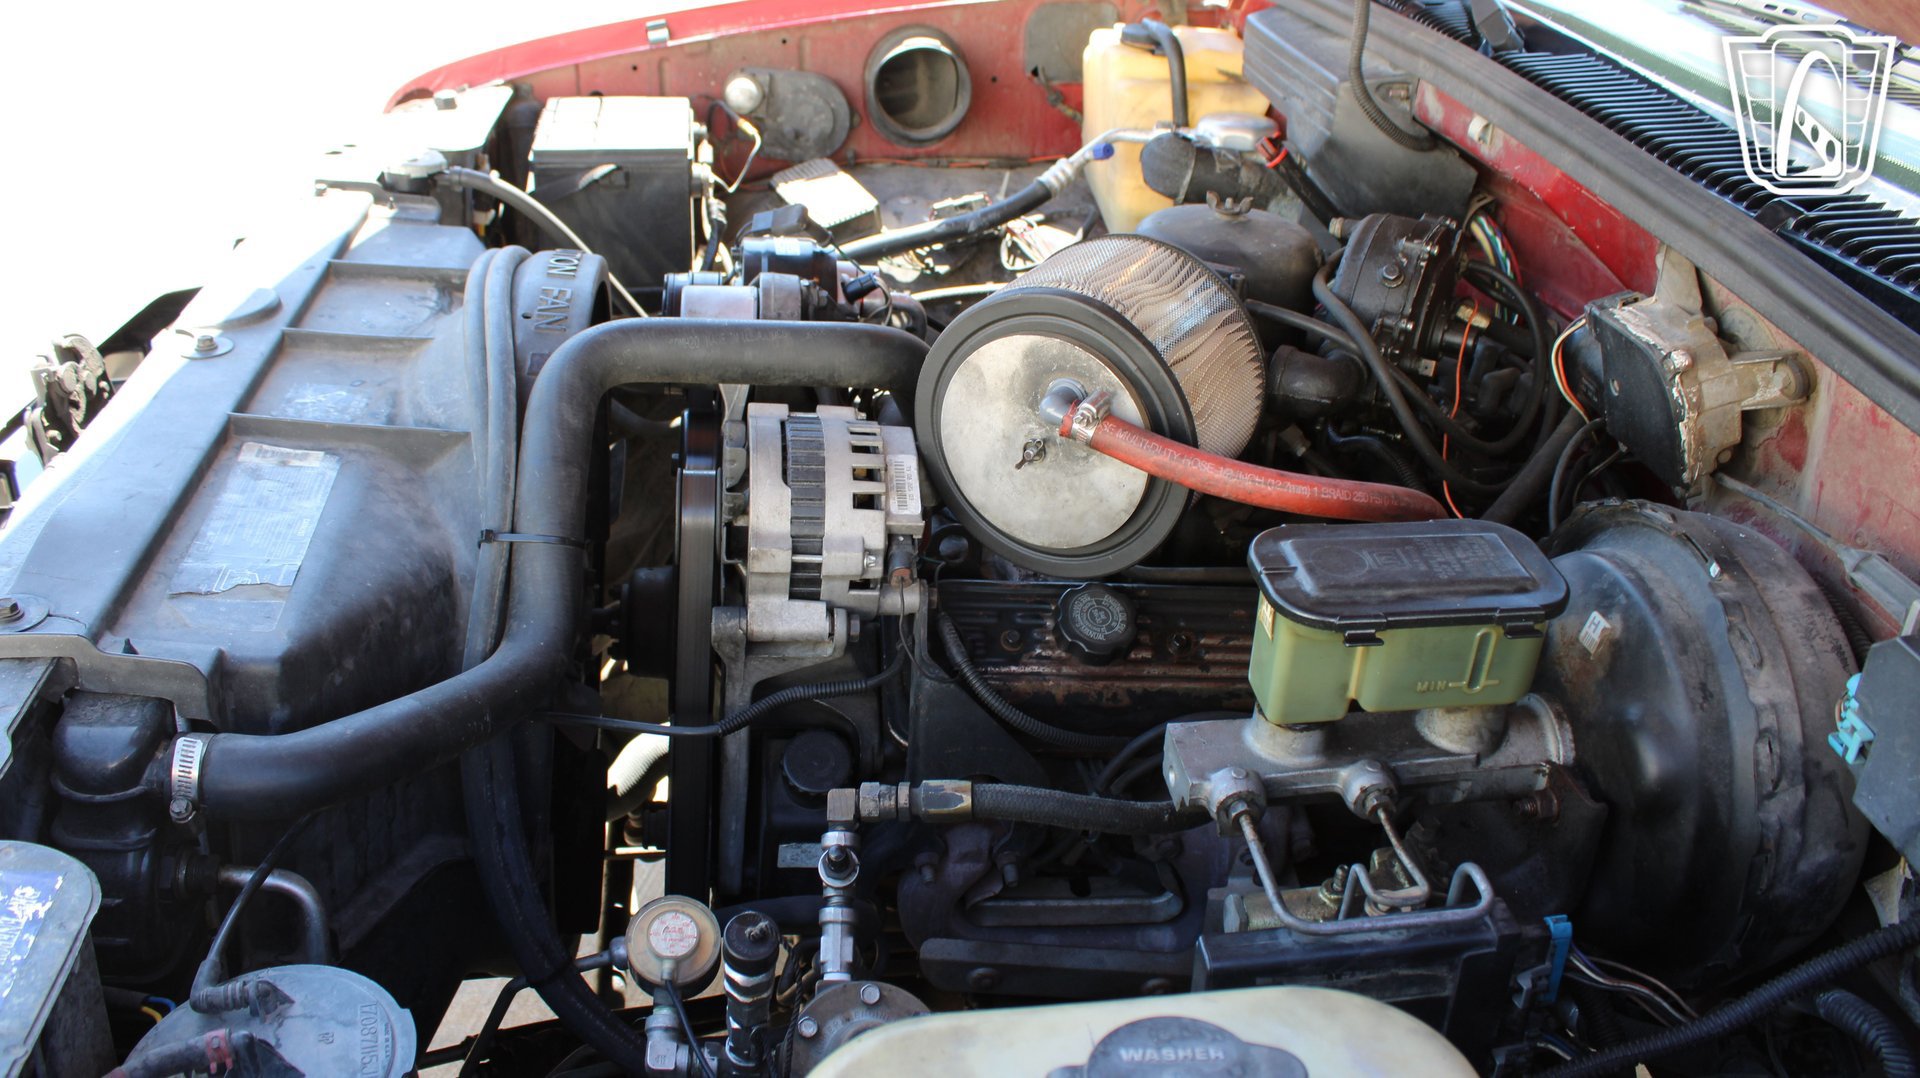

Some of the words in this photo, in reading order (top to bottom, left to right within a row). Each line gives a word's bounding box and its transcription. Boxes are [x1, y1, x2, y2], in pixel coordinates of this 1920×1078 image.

[535, 286, 572, 332] FAN
[1115, 428, 1181, 461] MULTI-DUTY
[1182, 456, 1217, 475] HOSE
[1321, 488, 1352, 501] BRAID
[1080, 625, 1107, 641] MANUAL
[1416, 679, 1447, 692] MIN
[360, 1001, 378, 1078] 17087115J
[1119, 1046, 1225, 1062] WASHER
